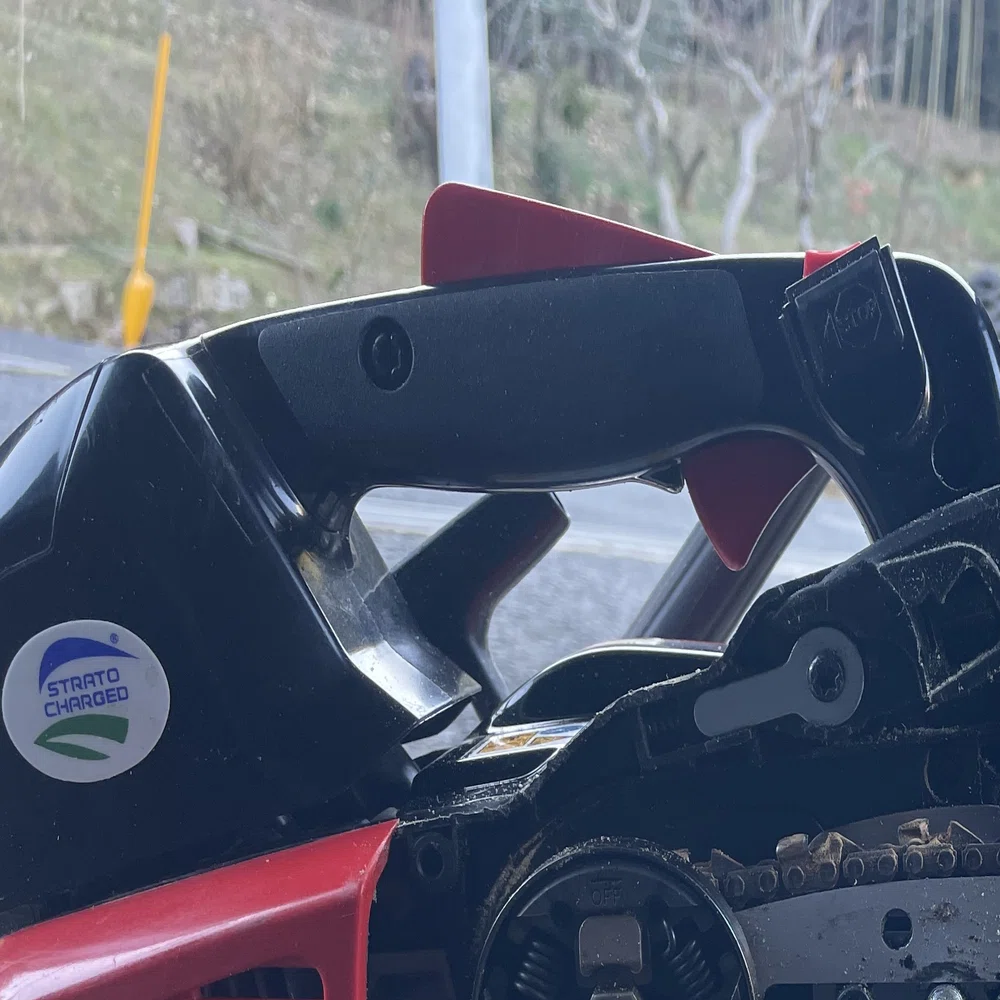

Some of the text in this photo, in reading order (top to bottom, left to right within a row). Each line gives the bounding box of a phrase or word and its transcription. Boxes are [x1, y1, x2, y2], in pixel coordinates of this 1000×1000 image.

[47, 667, 120, 697] STRATO
[44, 686, 129, 717] CHARGED
[592, 888, 623, 907] OFF
